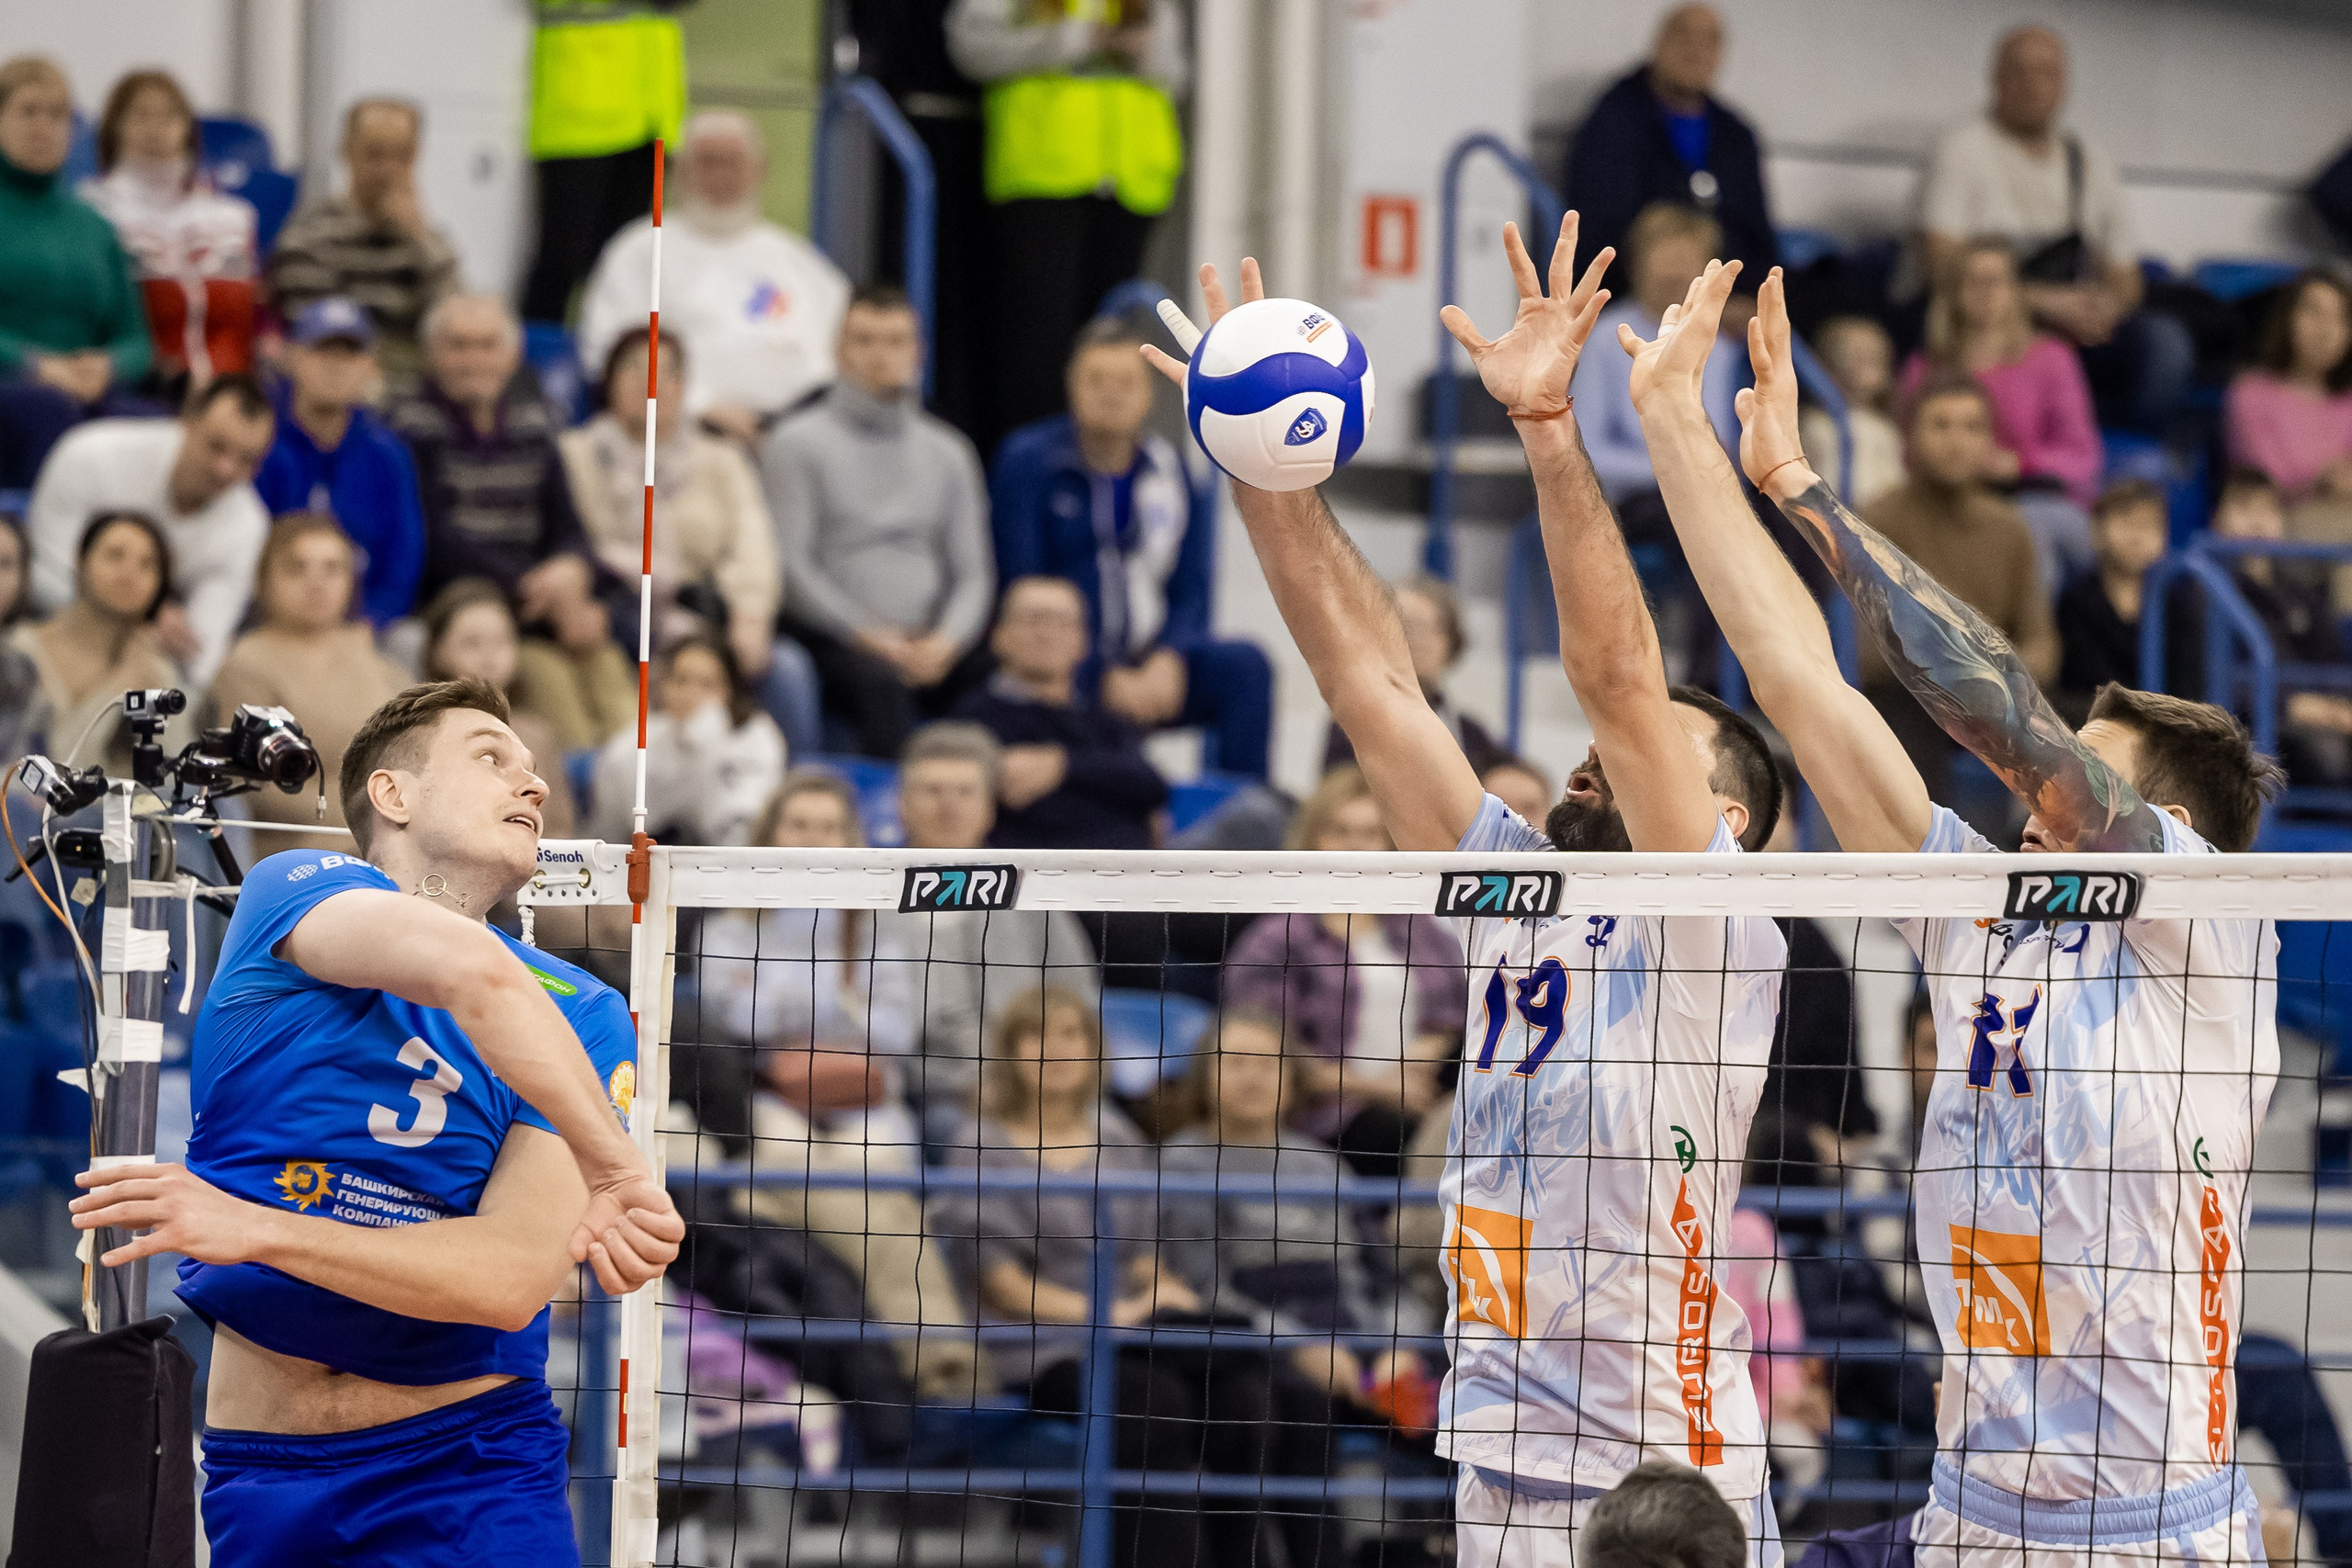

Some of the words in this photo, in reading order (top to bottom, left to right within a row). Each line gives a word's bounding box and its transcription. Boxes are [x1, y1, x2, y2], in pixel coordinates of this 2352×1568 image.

[544, 850, 584, 863] Senoh
[909, 869, 1008, 908] PARI
[1446, 874, 1552, 911] PARI
[2015, 875, 2128, 915] PARI
[1474, 950, 1572, 1079] 19
[368, 1036, 463, 1147] 3
